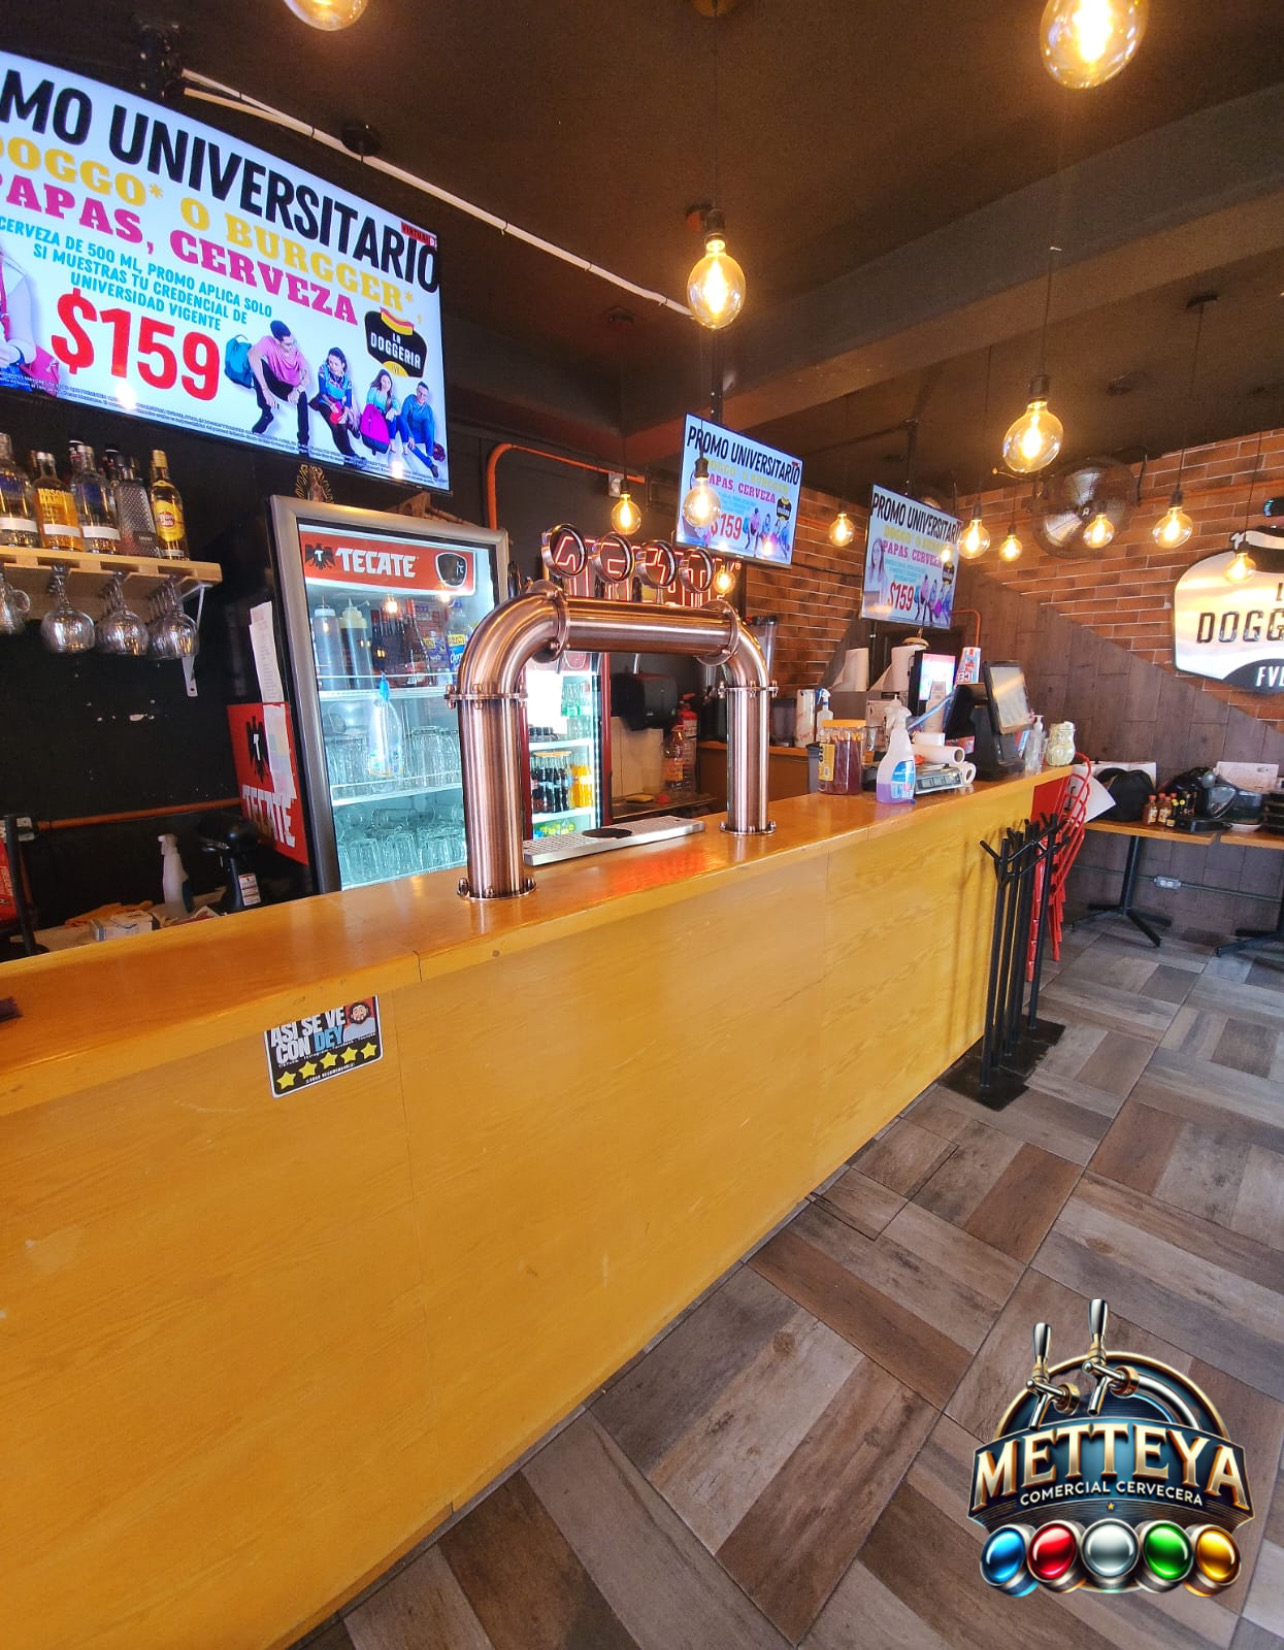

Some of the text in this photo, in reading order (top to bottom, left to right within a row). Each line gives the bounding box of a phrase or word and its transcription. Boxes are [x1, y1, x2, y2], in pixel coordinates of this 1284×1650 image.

[108, 104, 441, 294] UNIVERSITARIO
[180, 197, 211, 232] O
[0, 172, 359, 327] APAS, CERVEZA
[33, 241, 249, 326] SI MUESTRAS TU CREDENCIAL DE
[65, 235, 84, 252] DE
[87, 241, 117, 262] 500
[147, 257, 196, 289] PROMO
[199, 270, 241, 304] APLICA
[243, 293, 273, 319] SOLO
[70, 271, 222, 332] UNIVERSIDAD VIGENTE
[50, 287, 220, 402] $159
[686, 425, 801, 486] PROMO UNIVERSITARIO
[709, 474, 736, 492] APAS,
[738, 482, 776, 504] CERVEZA
[872, 492, 905, 527] PROMO
[334, 547, 417, 578] TECATE
[887, 580, 914, 612] $159
[276, 1025, 344, 1065] CON DEY
[301, 1014, 323, 1037] SE
[324, 1006, 346, 1028] VE
